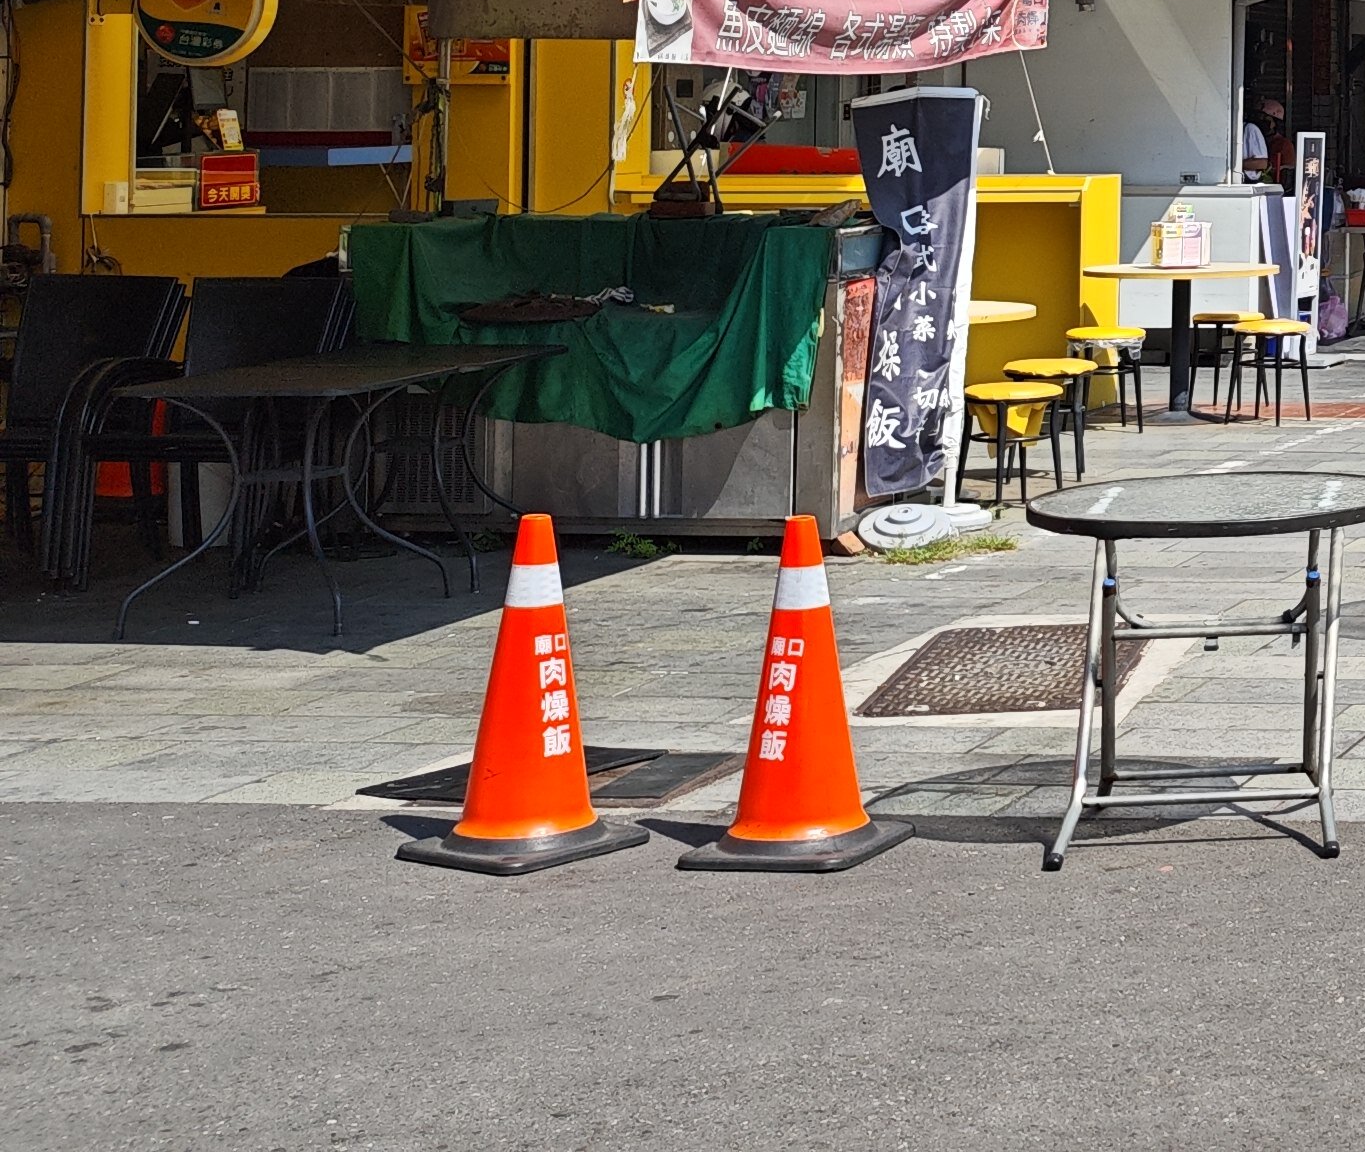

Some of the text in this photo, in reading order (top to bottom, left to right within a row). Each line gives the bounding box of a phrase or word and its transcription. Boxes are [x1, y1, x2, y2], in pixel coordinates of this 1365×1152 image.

[207, 185, 251, 203] 今天開獎
[534, 633, 567, 656] 廟口
[770, 637, 805, 658] 廟口
[539, 657, 571, 758] 肉燥飯
[758, 662, 797, 761] 肉燥飯
